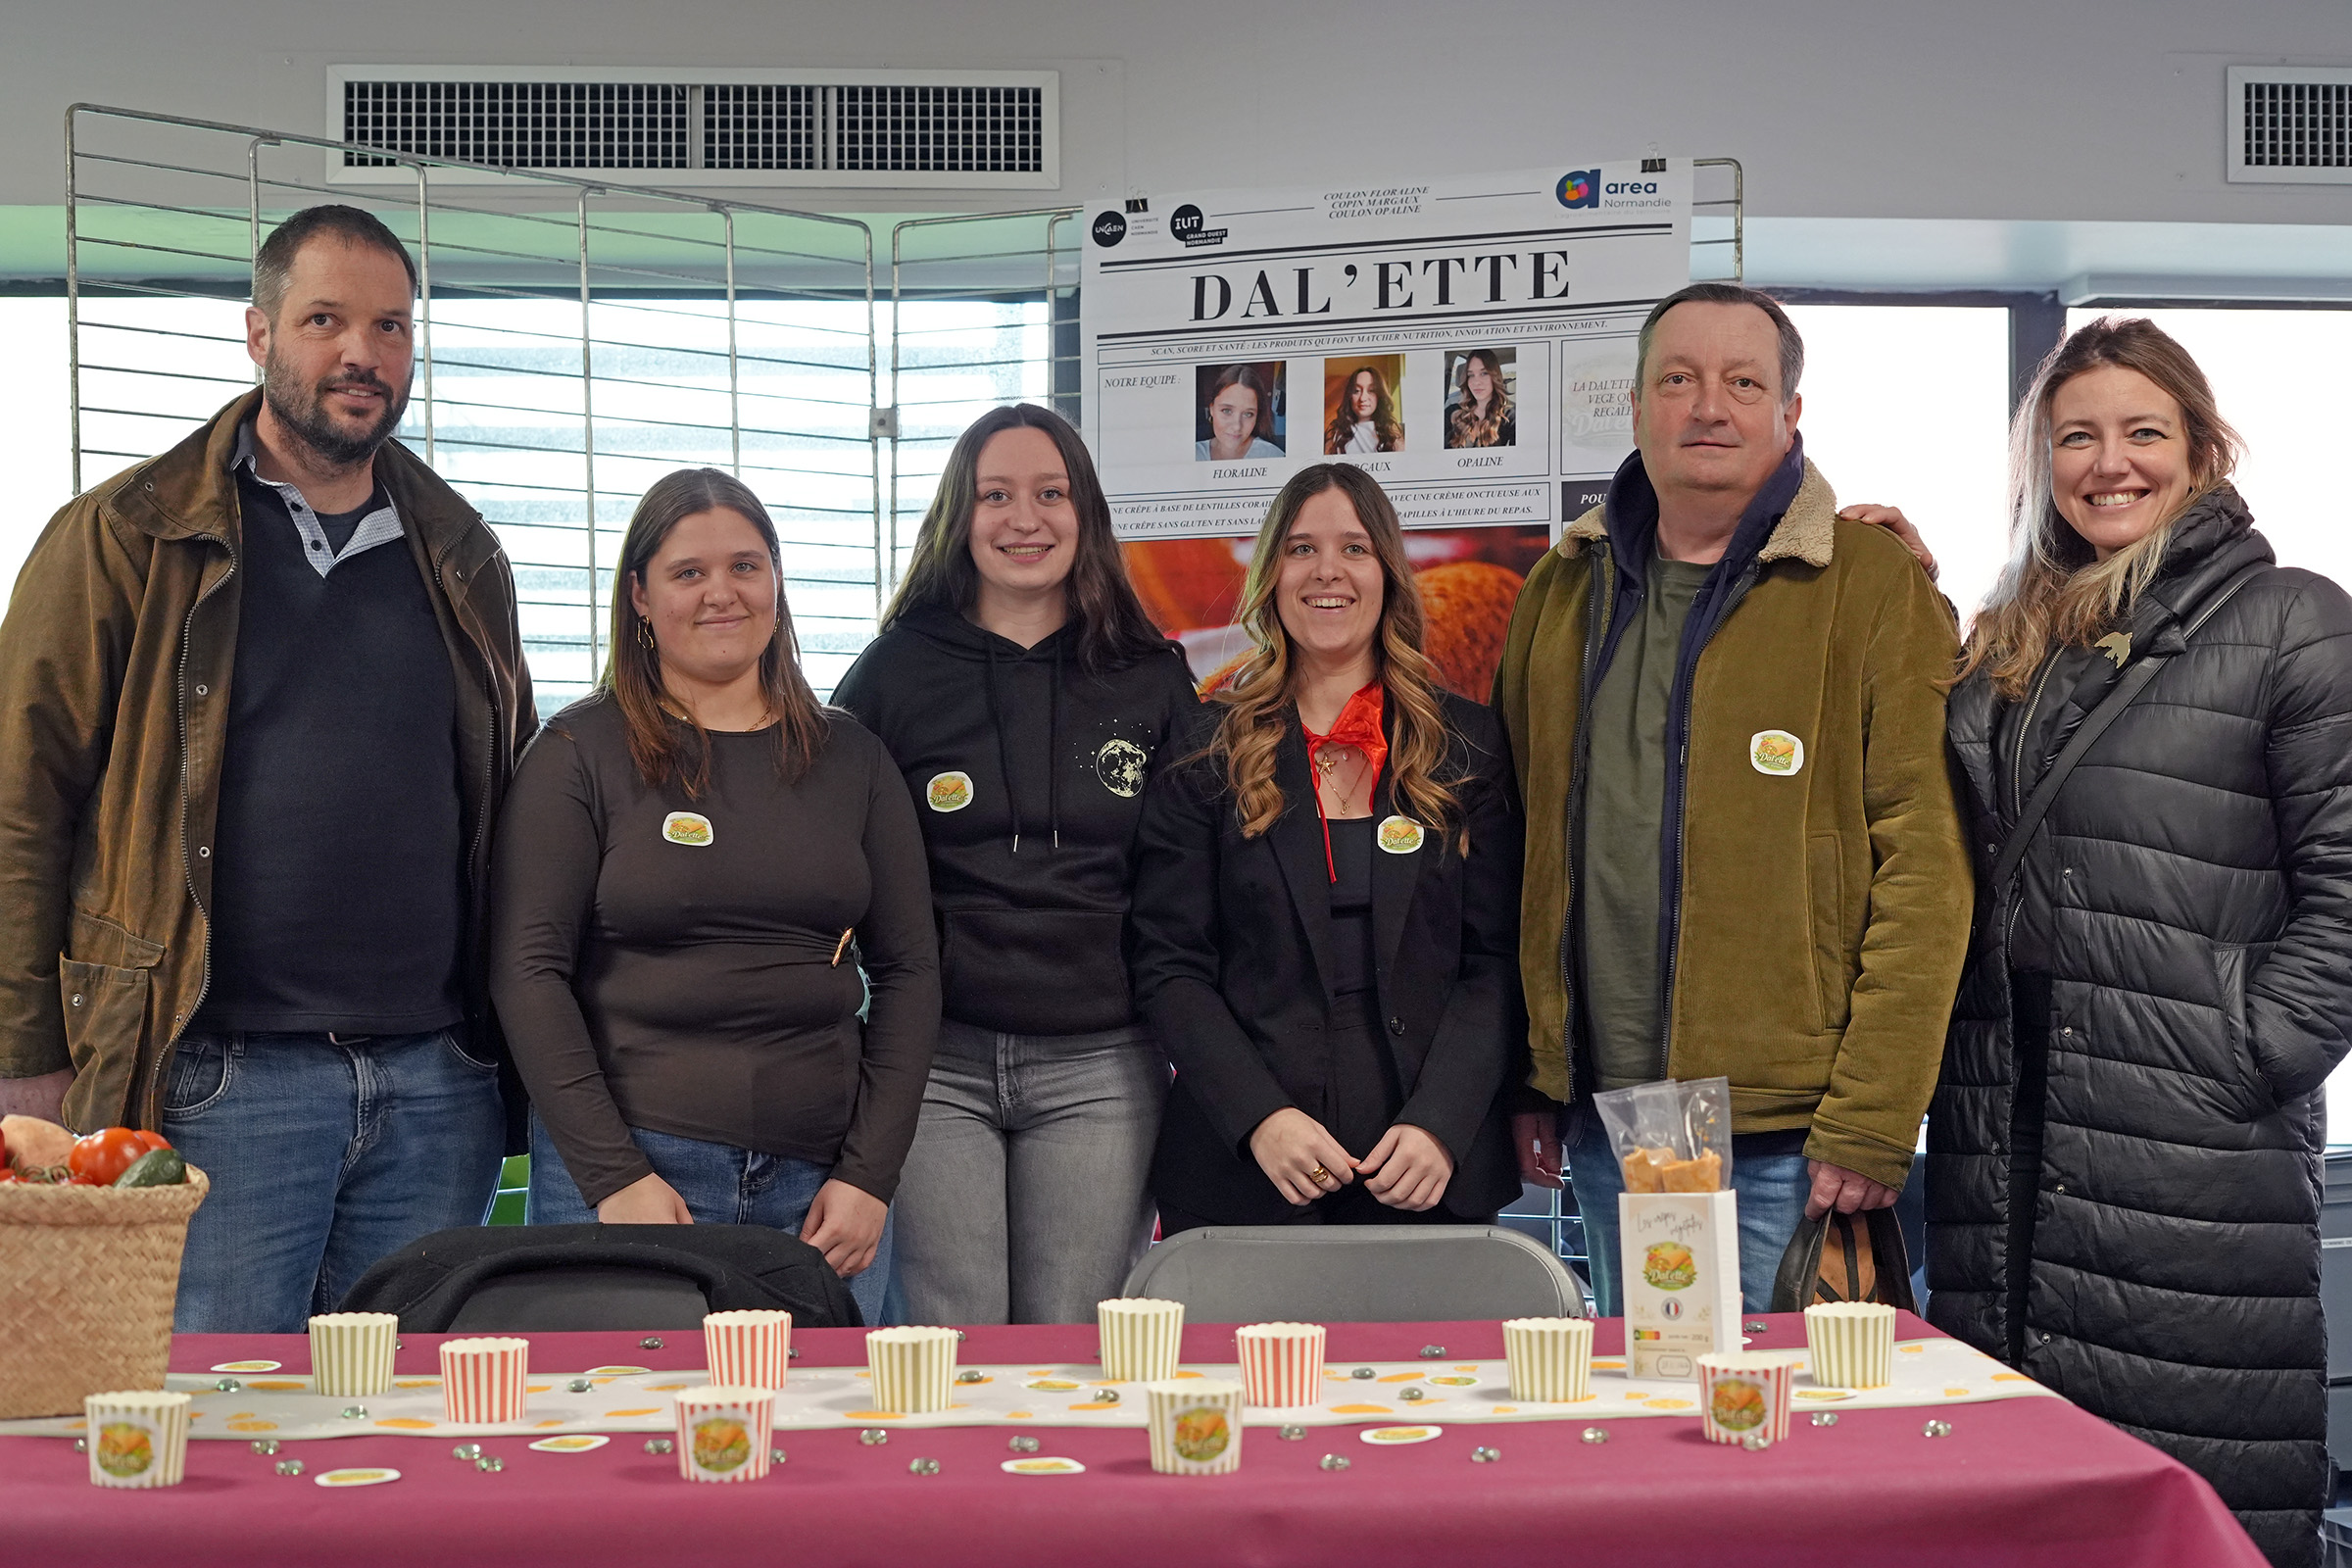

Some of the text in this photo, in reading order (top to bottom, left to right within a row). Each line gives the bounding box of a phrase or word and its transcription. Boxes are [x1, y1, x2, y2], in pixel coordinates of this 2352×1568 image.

[1323, 186, 1430, 201] COULON FLORALINE
[1605, 182, 1657, 194] area
[1331, 196, 1420, 210] COPIN MARGAUX
[1604, 198, 1672, 208] Normandie
[1329, 205, 1422, 220] COULON OPALINE
[1175, 216, 1200, 230] IUT
[1188, 251, 1569, 321] DAL'ETTE
[1151, 347, 1175, 356] SCAN,
[1176, 345, 1204, 354] SCORE
[1218, 341, 1246, 352] SANTÉ
[1251, 341, 1268, 350] LES
[1269, 339, 1313, 349] PRODUITS
[1314, 337, 1330, 347] QUI
[1332, 335, 1355, 344] FONT
[1356, 332, 1400, 343] MATCHER
[1402, 330, 1453, 340] NUTRITION,
[1454, 326, 1511, 337] INNOVATION
[1513, 325, 1526, 334] ET
[1526, 320, 1608, 332] ENVIRONNEMENT.
[1104, 377, 1138, 388] NOTRE
[1140, 375, 1177, 388] EQUIPE
[1573, 381, 1586, 392] LA
[1589, 393, 1615, 404] VEGE
[1354, 462, 1391, 471] RGAUX
[1457, 456, 1504, 468] OPALINE
[1212, 467, 1267, 479] FLORALINE
[1433, 490, 1464, 500] CRÈME
[1466, 489, 1520, 499] ONCTUEUSE
[1521, 488, 1542, 497] AUX
[1580, 493, 1607, 505] POU
[1124, 504, 1152, 514] CRÊPE
[1160, 504, 1181, 513] BASE
[1195, 502, 1241, 511] LENTILLES
[1446, 508, 1486, 516] L'HEURE
[1501, 506, 1533, 514] REPAS.
[1129, 519, 1156, 530] CRÊPE
[1157, 520, 1179, 529] SANS
[1180, 519, 1214, 528] GLUTEN
